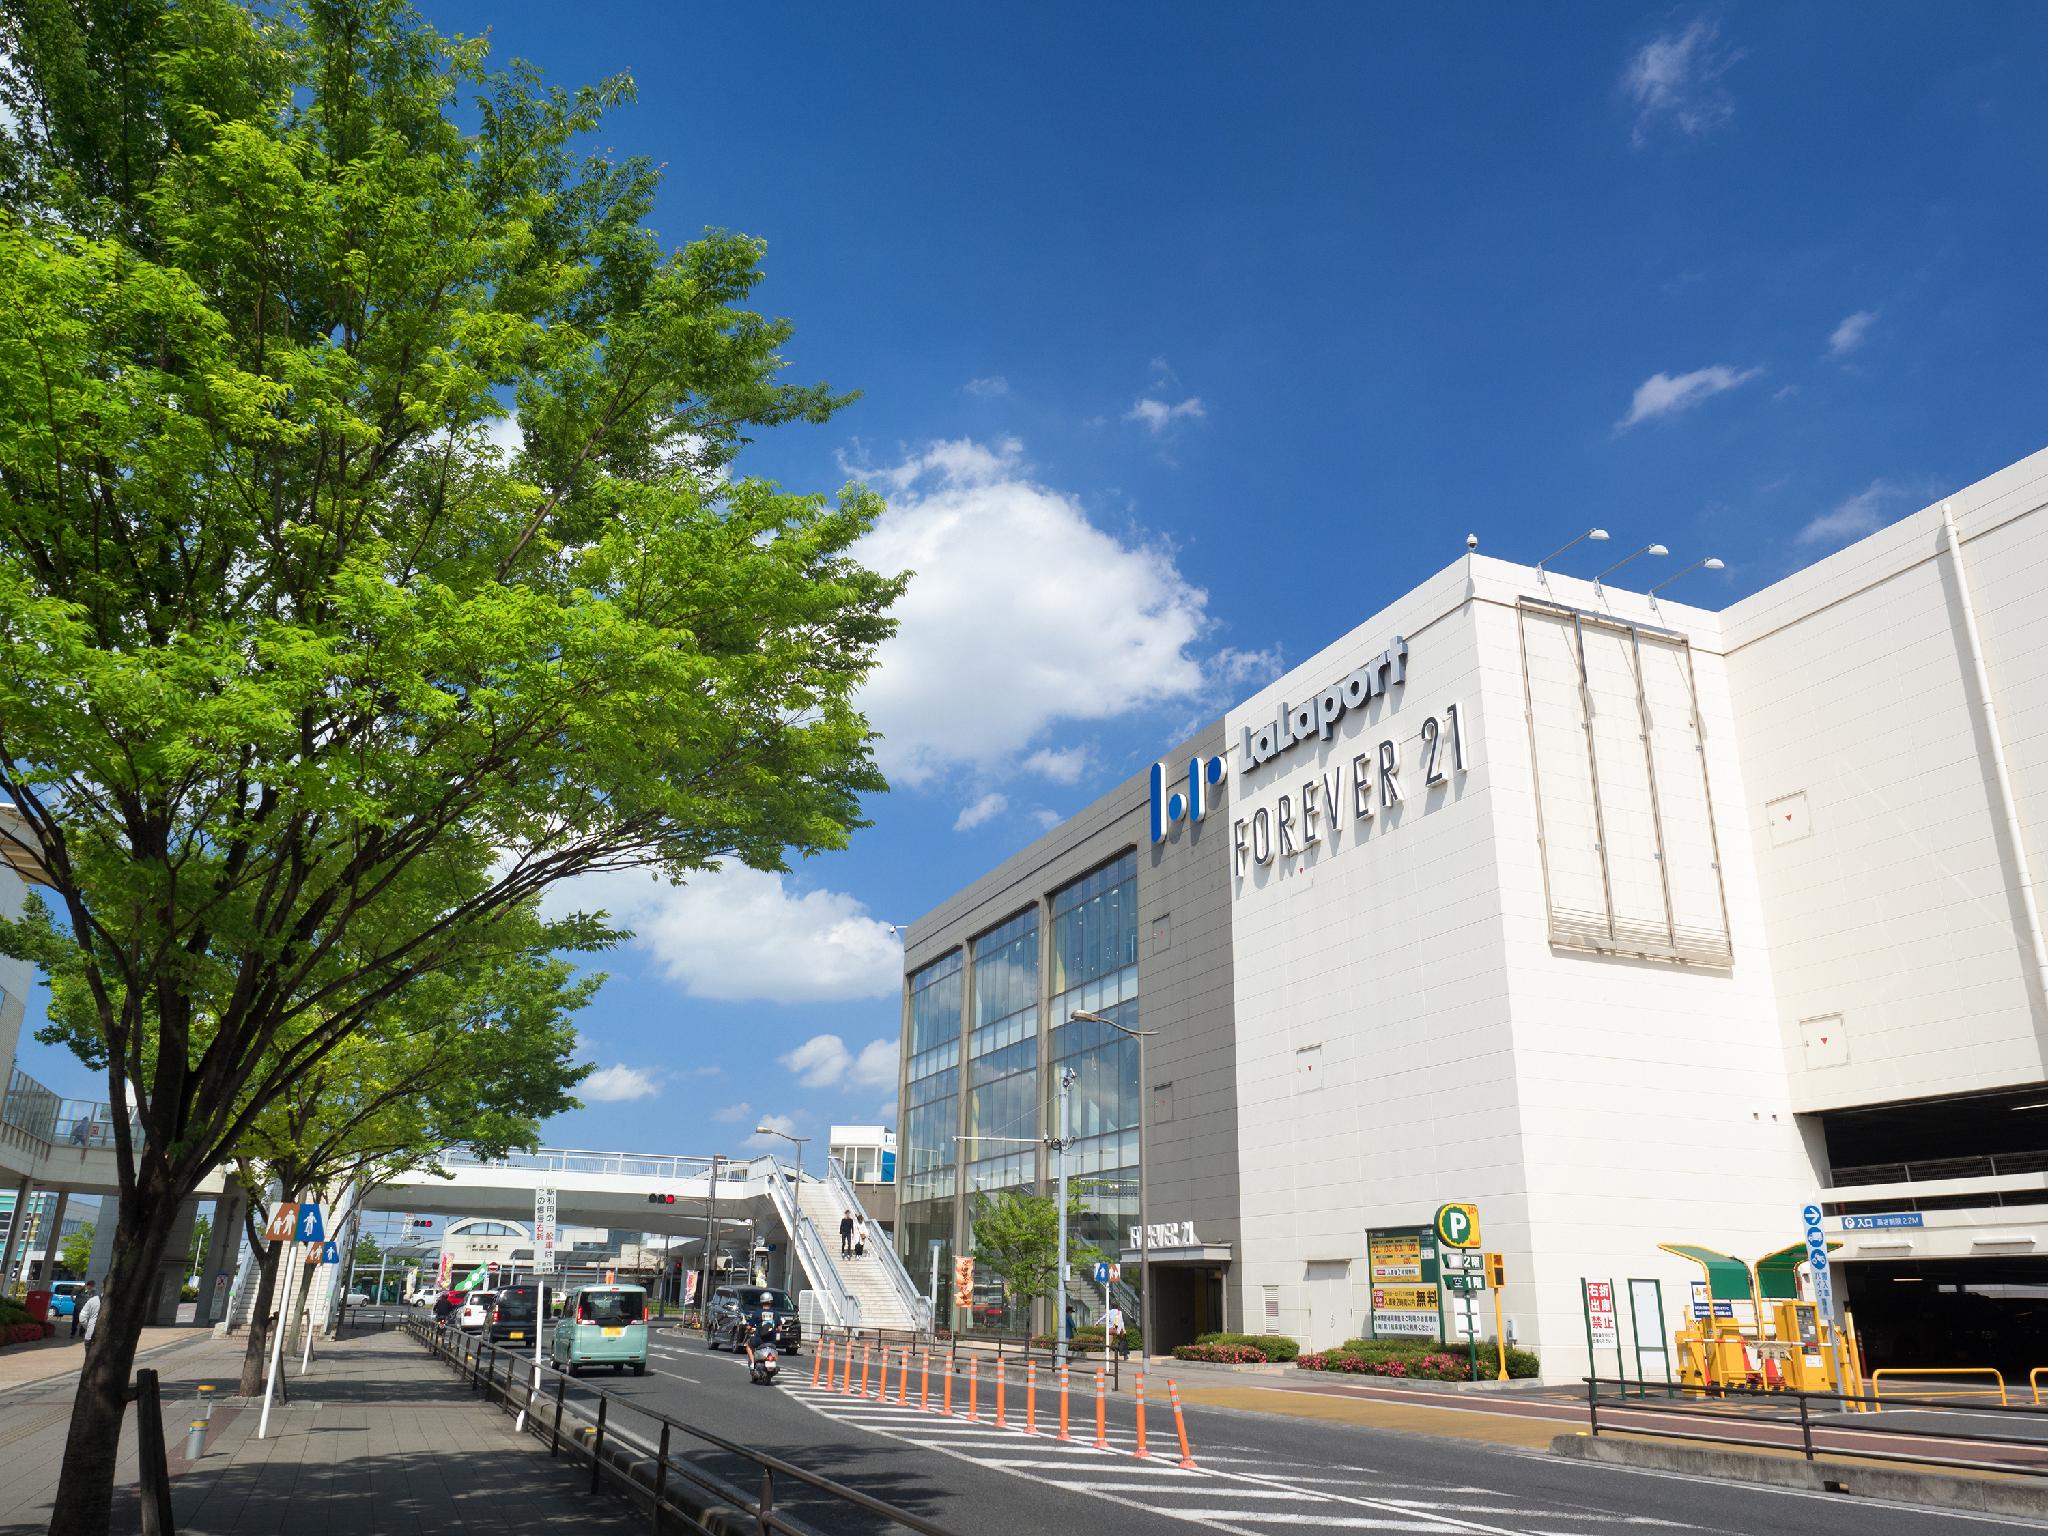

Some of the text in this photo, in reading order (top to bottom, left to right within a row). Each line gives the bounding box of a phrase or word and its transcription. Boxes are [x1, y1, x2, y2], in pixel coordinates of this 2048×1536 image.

[1240, 636, 1408, 774] LaLaport
[1234, 702, 1470, 878] FOREVER 21
[1450, 1212, 1466, 1239] P
[1857, 1218, 1873, 1228] 入口
[1588, 1284, 1609, 1297] 右折
[1416, 1290, 1437, 1308] 無料
[1590, 1299, 1612, 1312] 出庫
[1591, 1316, 1614, 1329] 禁止
